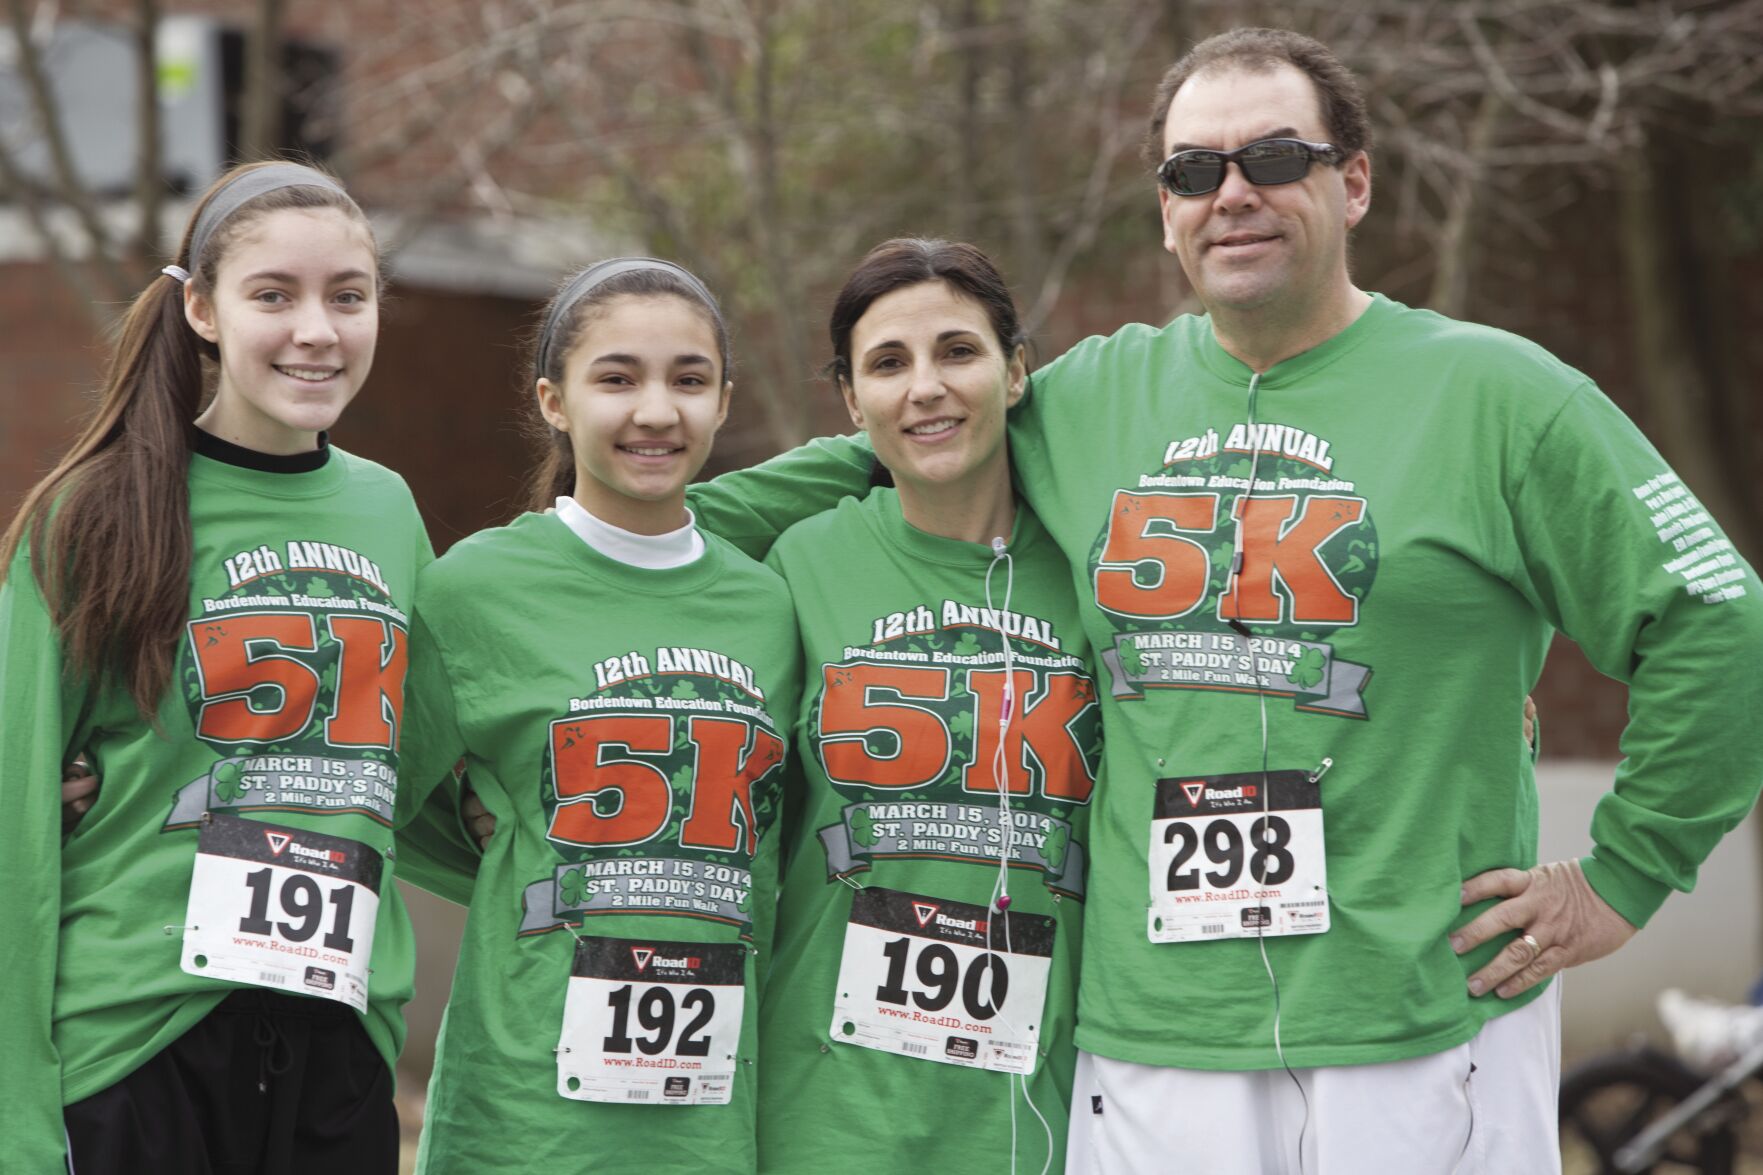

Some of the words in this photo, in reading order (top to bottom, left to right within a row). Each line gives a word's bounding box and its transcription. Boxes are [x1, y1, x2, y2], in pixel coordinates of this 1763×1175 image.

[1164, 428, 1219, 465] 12th
[1224, 424, 1333, 470] ANNUAL
[1139, 474, 1206, 488] Bordentown
[1278, 477, 1354, 492] Foundation
[225, 545, 282, 587] 12th
[287, 541, 390, 595] ANNUAL
[1094, 489, 1367, 626] 5K
[204, 594, 289, 612] Bordentown
[291, 594, 356, 610] Education
[873, 605, 934, 643] 12th
[942, 599, 1060, 650] ANNUAL
[844, 646, 928, 662] Bordentown
[932, 651, 1004, 666] Education
[1134, 634, 1202, 649] MARCH
[1250, 638, 1301, 658] 2014
[594, 651, 650, 688] 12th
[656, 647, 764, 699] ANNUAL
[1139, 652, 1166, 667] ST.
[1172, 652, 1251, 671] PADDY'S
[1257, 658, 1295, 675] DAY
[1161, 670, 1169, 680] 2
[1172, 669, 1200, 681] Mile
[1204, 671, 1231, 683] Fun
[187, 611, 408, 753] 5K
[570, 696, 653, 712] Bordentown
[654, 697, 722, 711] Education
[818, 661, 1098, 805] 5K
[242, 757, 312, 772] MARCH
[240, 775, 271, 790] ST.
[279, 775, 367, 793] PADDY'S
[374, 781, 396, 806] DAY
[546, 713, 785, 859] 5K
[1205, 785, 1257, 800] RoadID
[265, 792, 276, 803] 2
[280, 791, 313, 804] Mile
[316, 796, 345, 806] Fun
[351, 795, 381, 812] Walk
[869, 804, 947, 819] MARCH
[873, 823, 904, 837] ST.
[913, 822, 1000, 843] PADDY'S
[1009, 831, 1047, 849] DAY
[898, 840, 908, 850] 2
[913, 839, 946, 851] Mile
[951, 842, 978, 854] Fun
[289, 842, 345, 864] RoadID
[1164, 815, 1294, 892] 298
[585, 861, 664, 877] MARCH
[704, 866, 752, 888] 2014
[587, 879, 620, 894] ST.
[628, 879, 706, 897] PADDY'S
[710, 885, 749, 904] DAY
[612, 896, 623, 906] 2
[628, 895, 659, 907] Mile
[665, 896, 690, 908] Fun
[692, 899, 719, 913] Walk
[1175, 889, 1281, 904] www.RoadID.com
[239, 867, 355, 954] 191
[233, 937, 349, 966] www.RoadID.com
[653, 955, 701, 969] RoadID
[876, 937, 1009, 1021] 190
[603, 984, 715, 1057] 192
[878, 1005, 992, 1035] www.RoadID.com
[603, 1056, 702, 1070] www.RoadID.com
